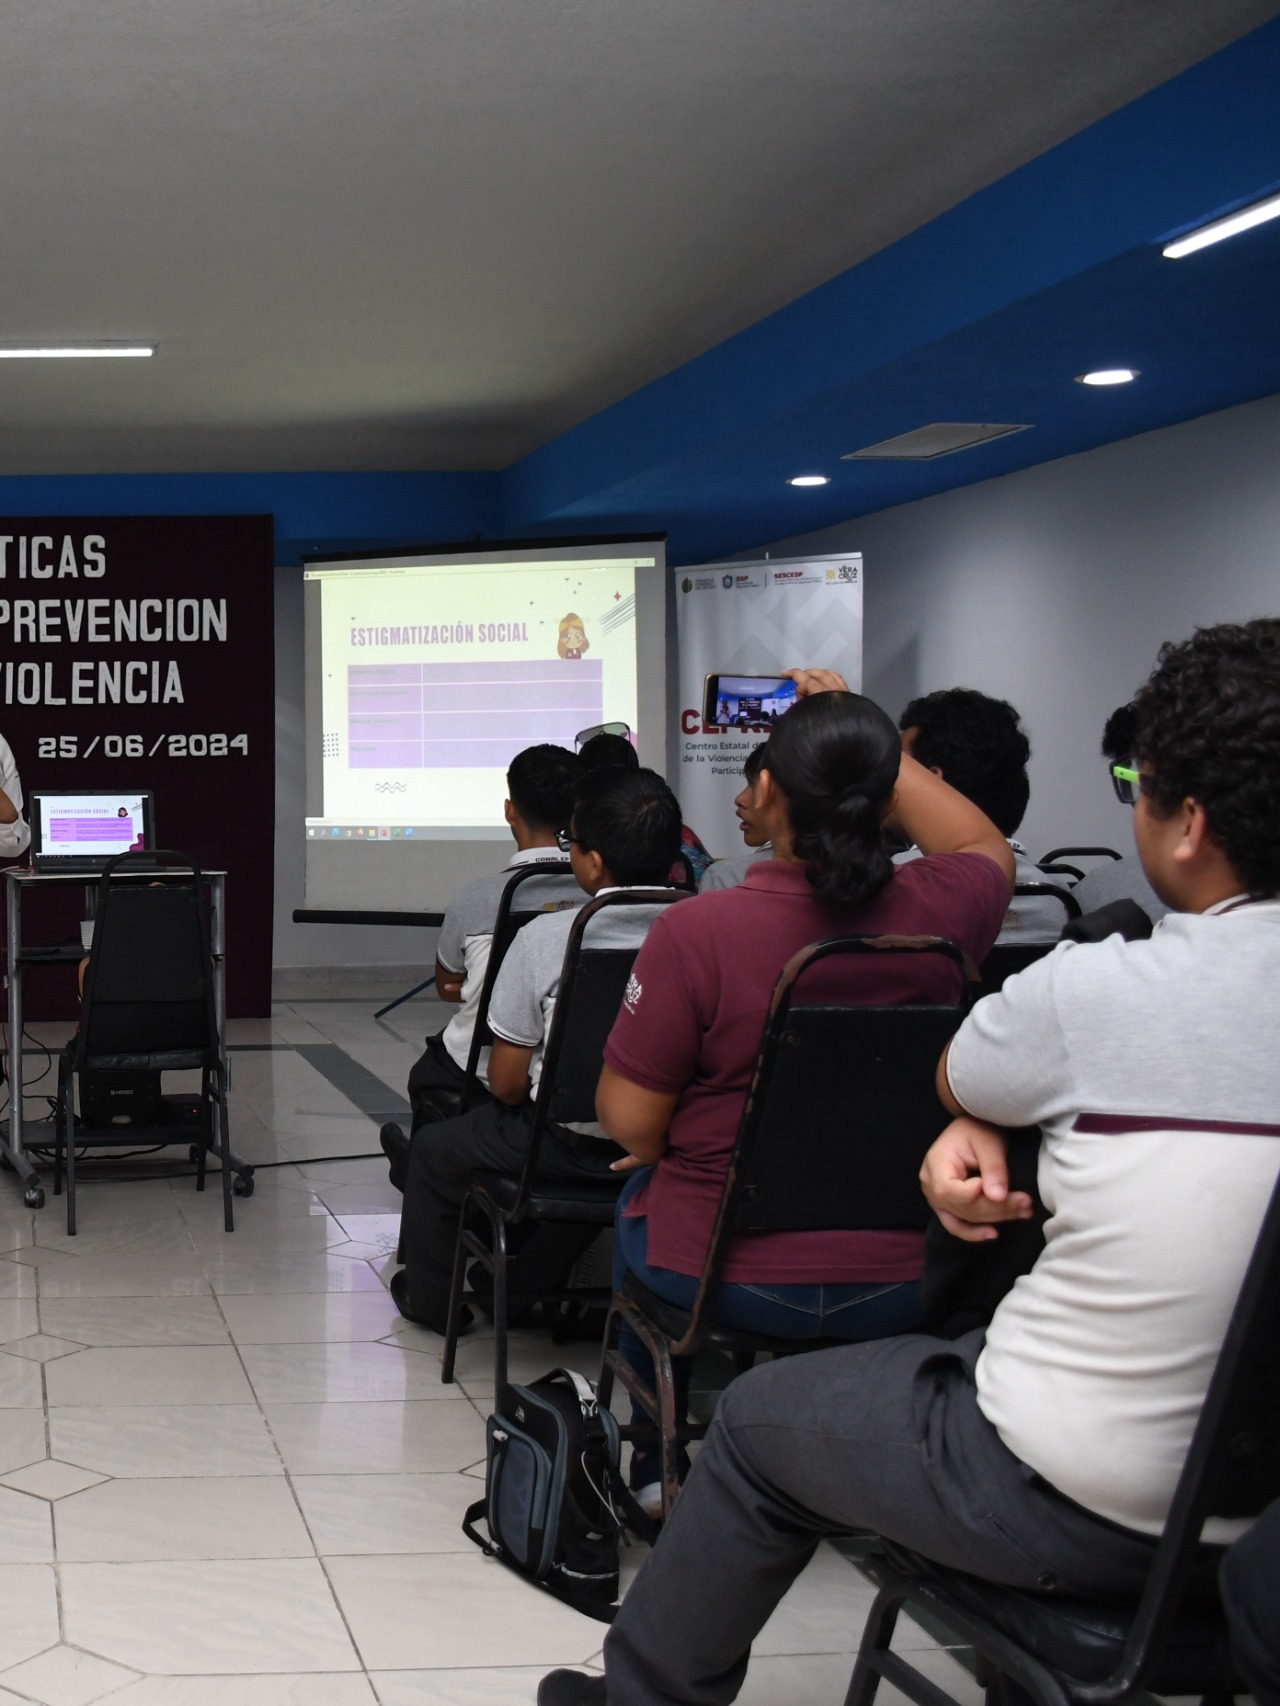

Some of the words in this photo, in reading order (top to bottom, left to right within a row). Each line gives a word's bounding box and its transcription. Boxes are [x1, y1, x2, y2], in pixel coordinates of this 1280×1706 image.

[351, 621, 474, 646] ESTIGMATIZACIÓN
[478, 622, 528, 643] SOCIAL
[39, 734, 248, 759] 25/06/2024
[685, 742, 718, 750] Centro
[720, 741, 749, 749] Estatal
[696, 754, 705, 762] la
[711, 767, 745, 776] Particip
